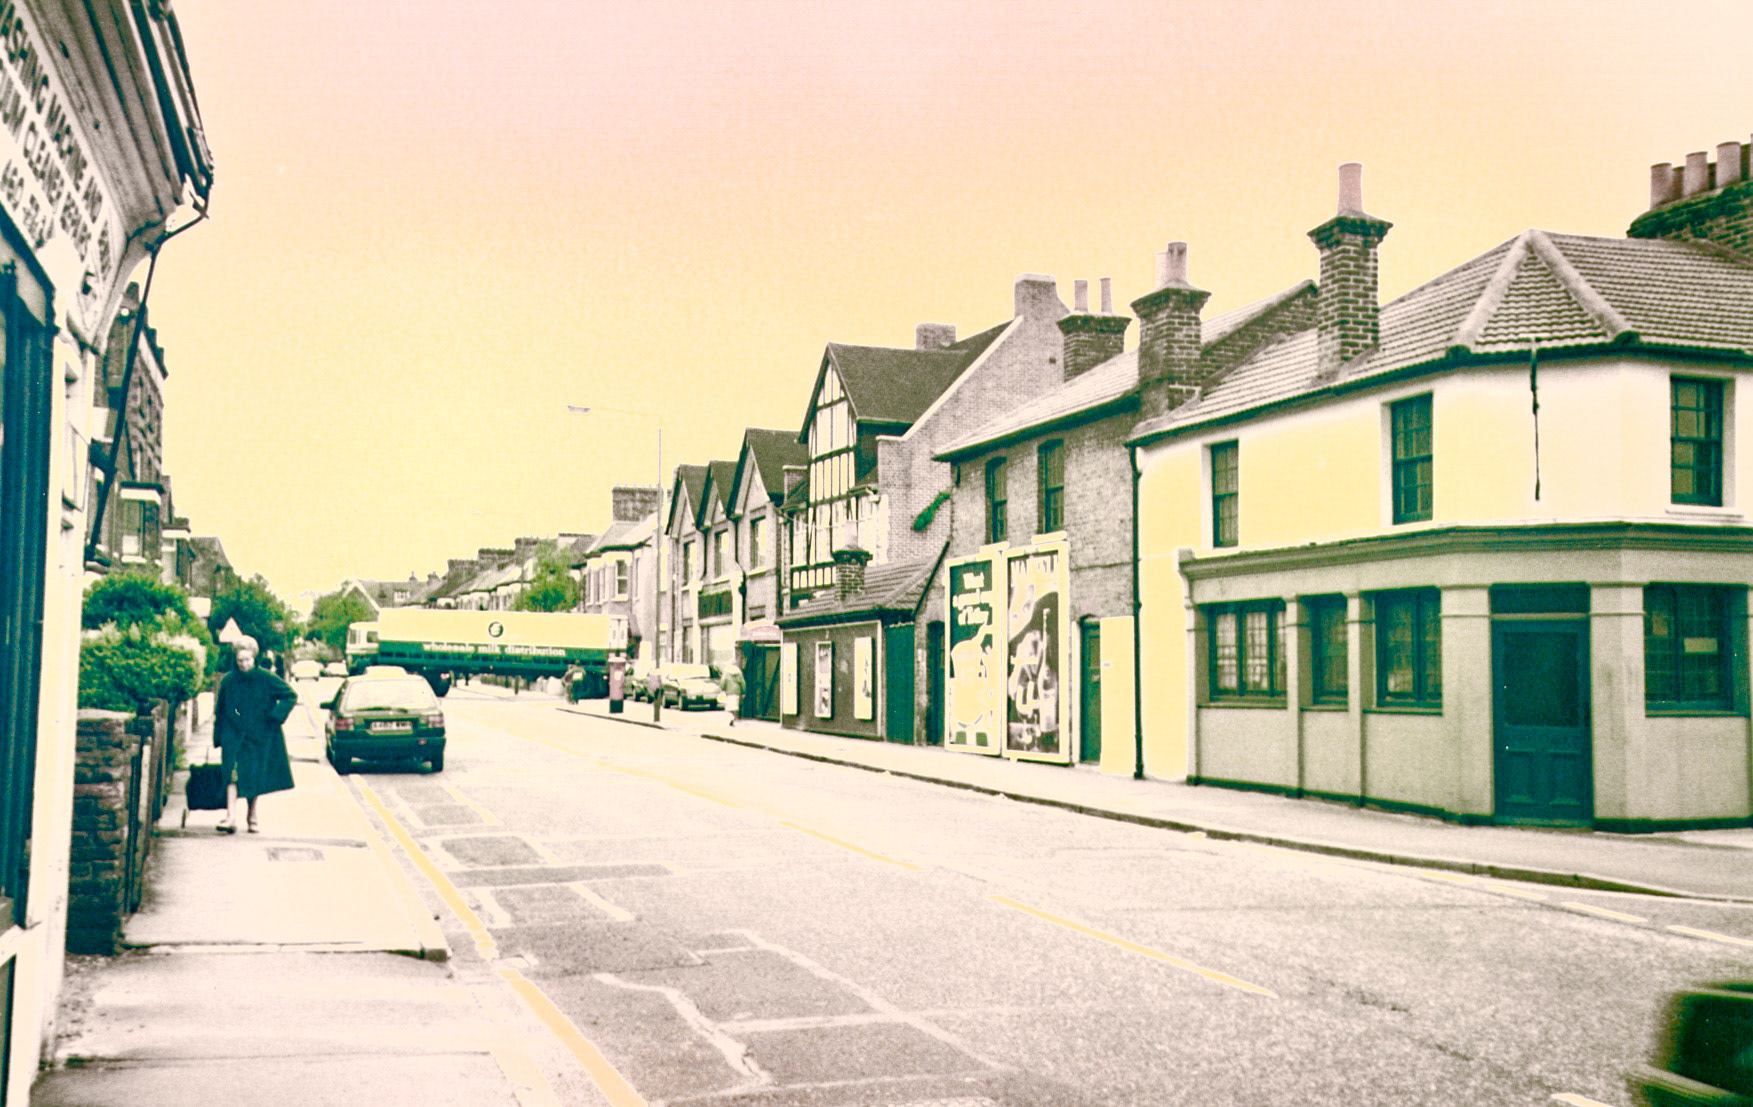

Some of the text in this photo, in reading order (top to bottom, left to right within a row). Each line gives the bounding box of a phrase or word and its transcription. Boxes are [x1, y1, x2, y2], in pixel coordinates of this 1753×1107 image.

[81, 174, 103, 224] AND
[422, 641, 567, 657] wholesale milk distribution
